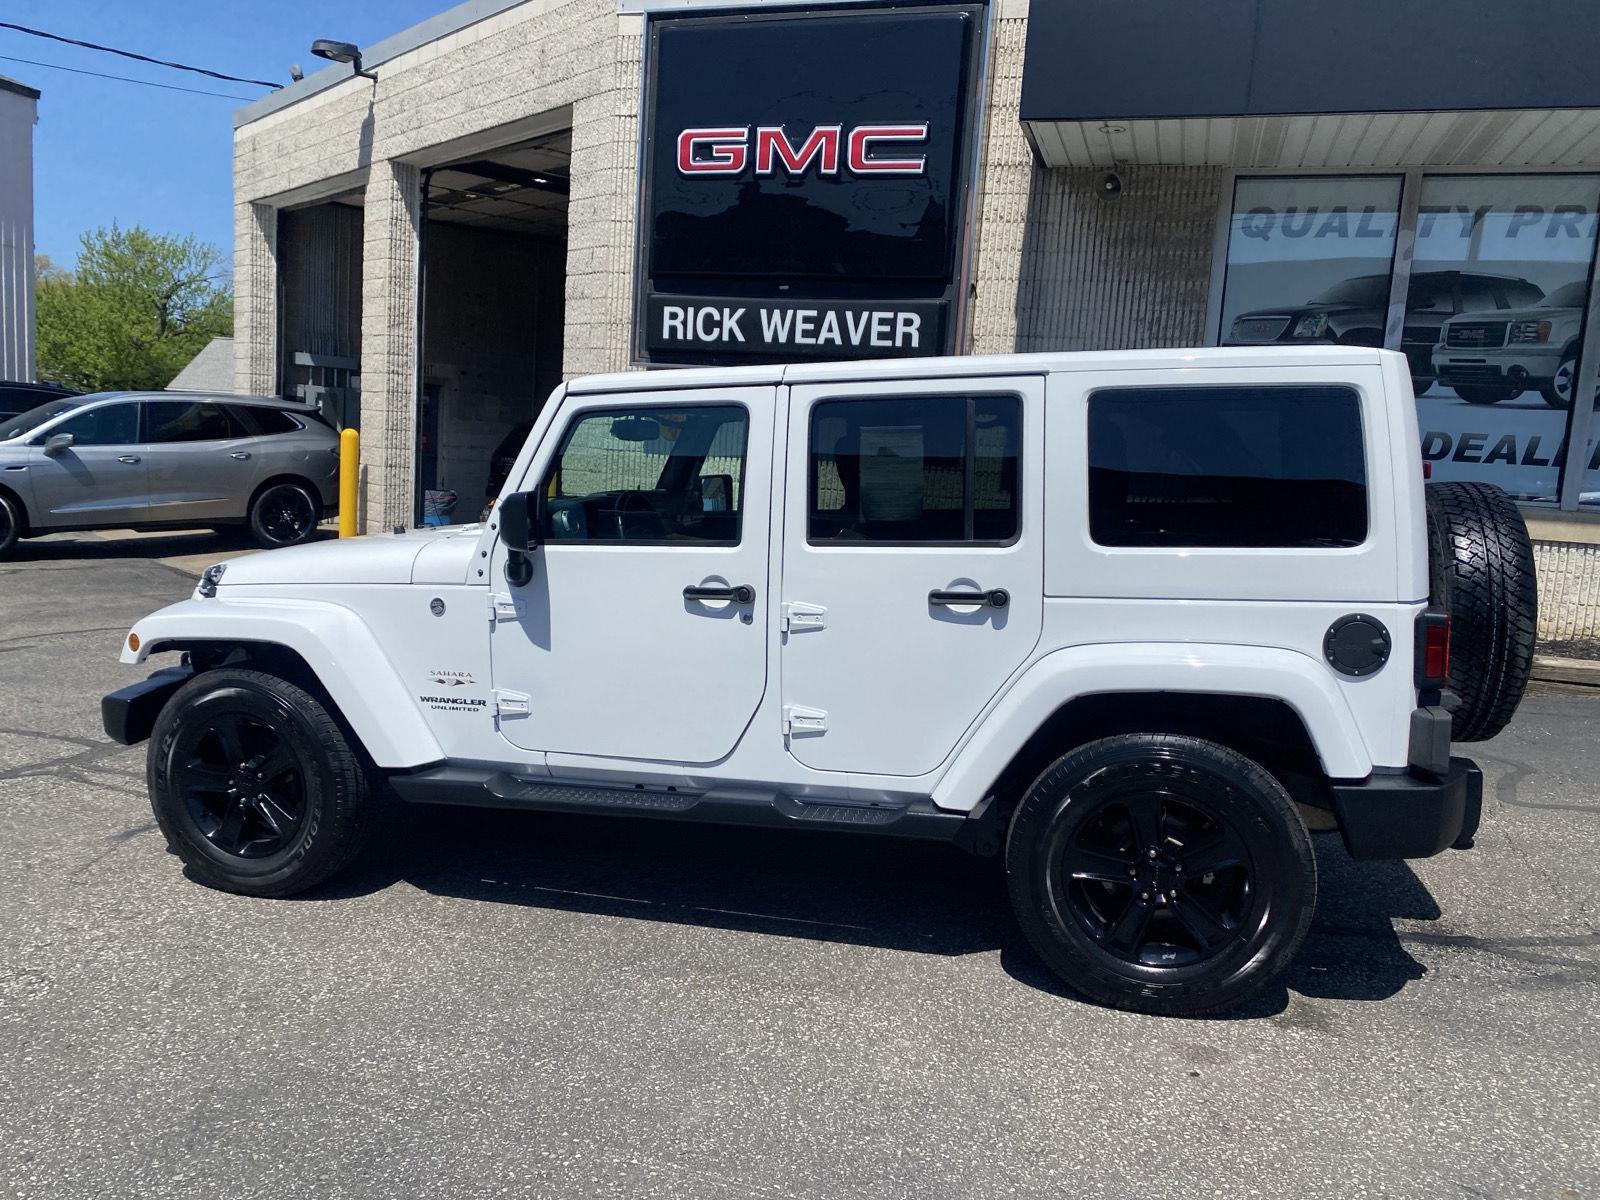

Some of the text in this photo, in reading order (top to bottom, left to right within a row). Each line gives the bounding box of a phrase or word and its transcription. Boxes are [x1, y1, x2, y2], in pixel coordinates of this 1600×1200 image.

[677, 125, 929, 175] GMC
[662, 306, 922, 348] RICK WEAVER
[430, 669, 473, 678] SAHARA
[419, 695, 487, 707] WRANGLER
